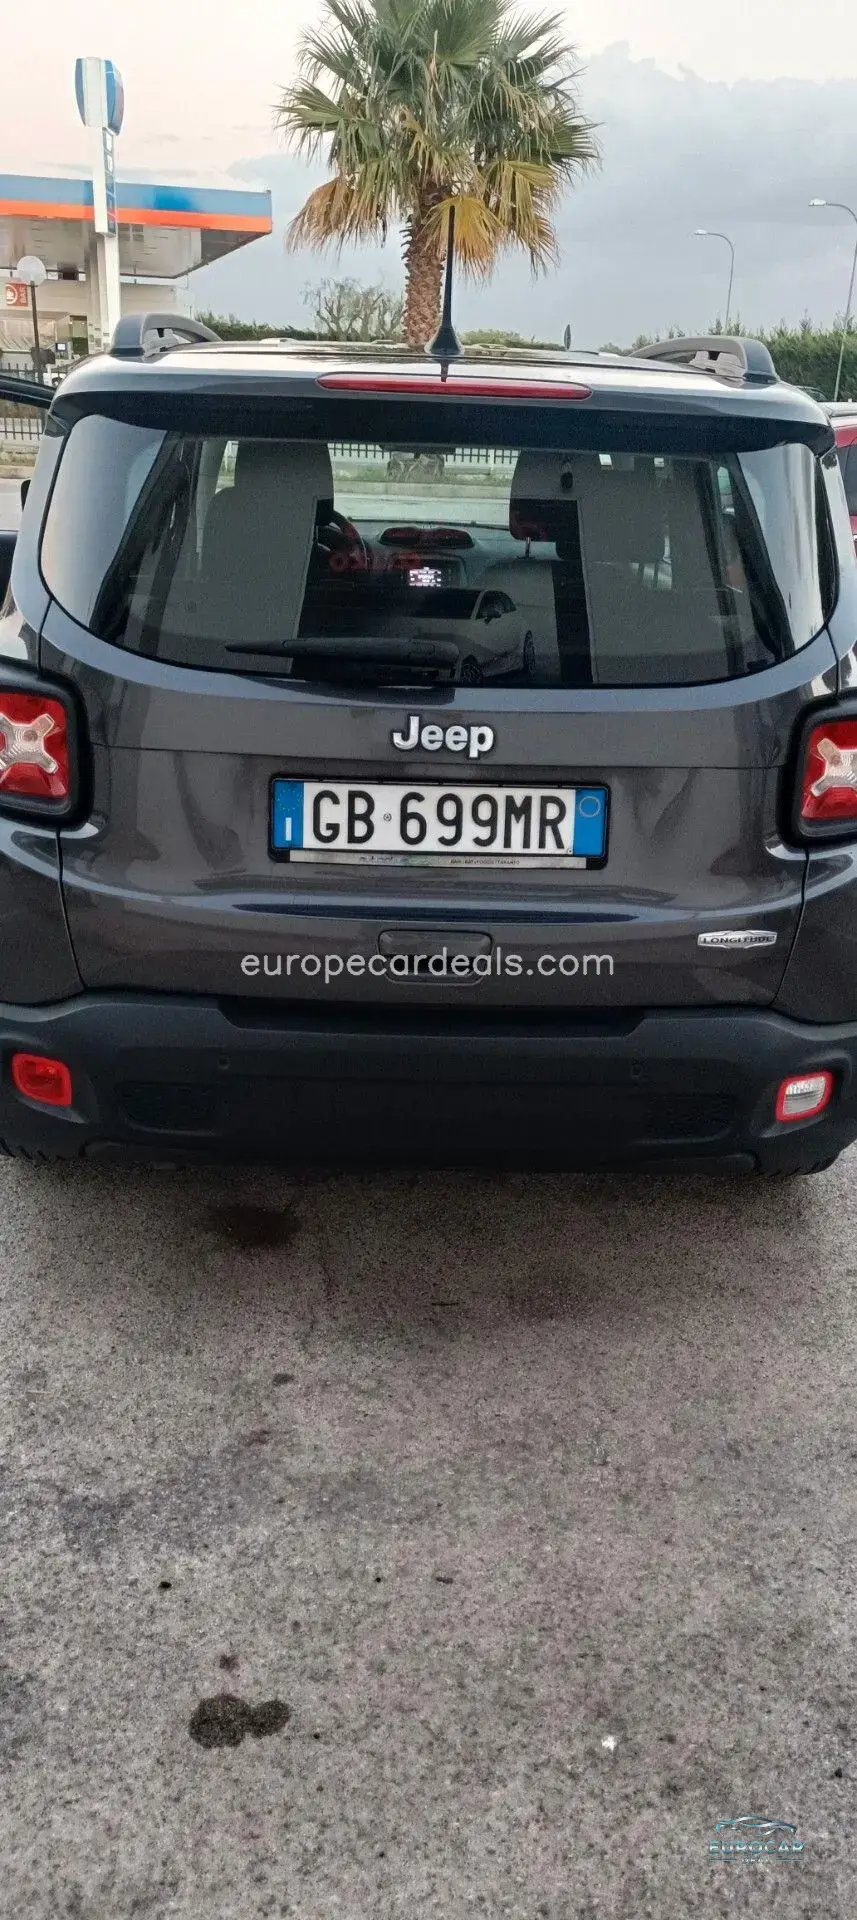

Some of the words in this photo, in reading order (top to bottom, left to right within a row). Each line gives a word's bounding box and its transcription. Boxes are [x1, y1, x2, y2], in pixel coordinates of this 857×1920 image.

[392, 716, 494, 758] Jeep
[312, 789, 375, 844] GB
[400, 791, 567, 849] 699MR
